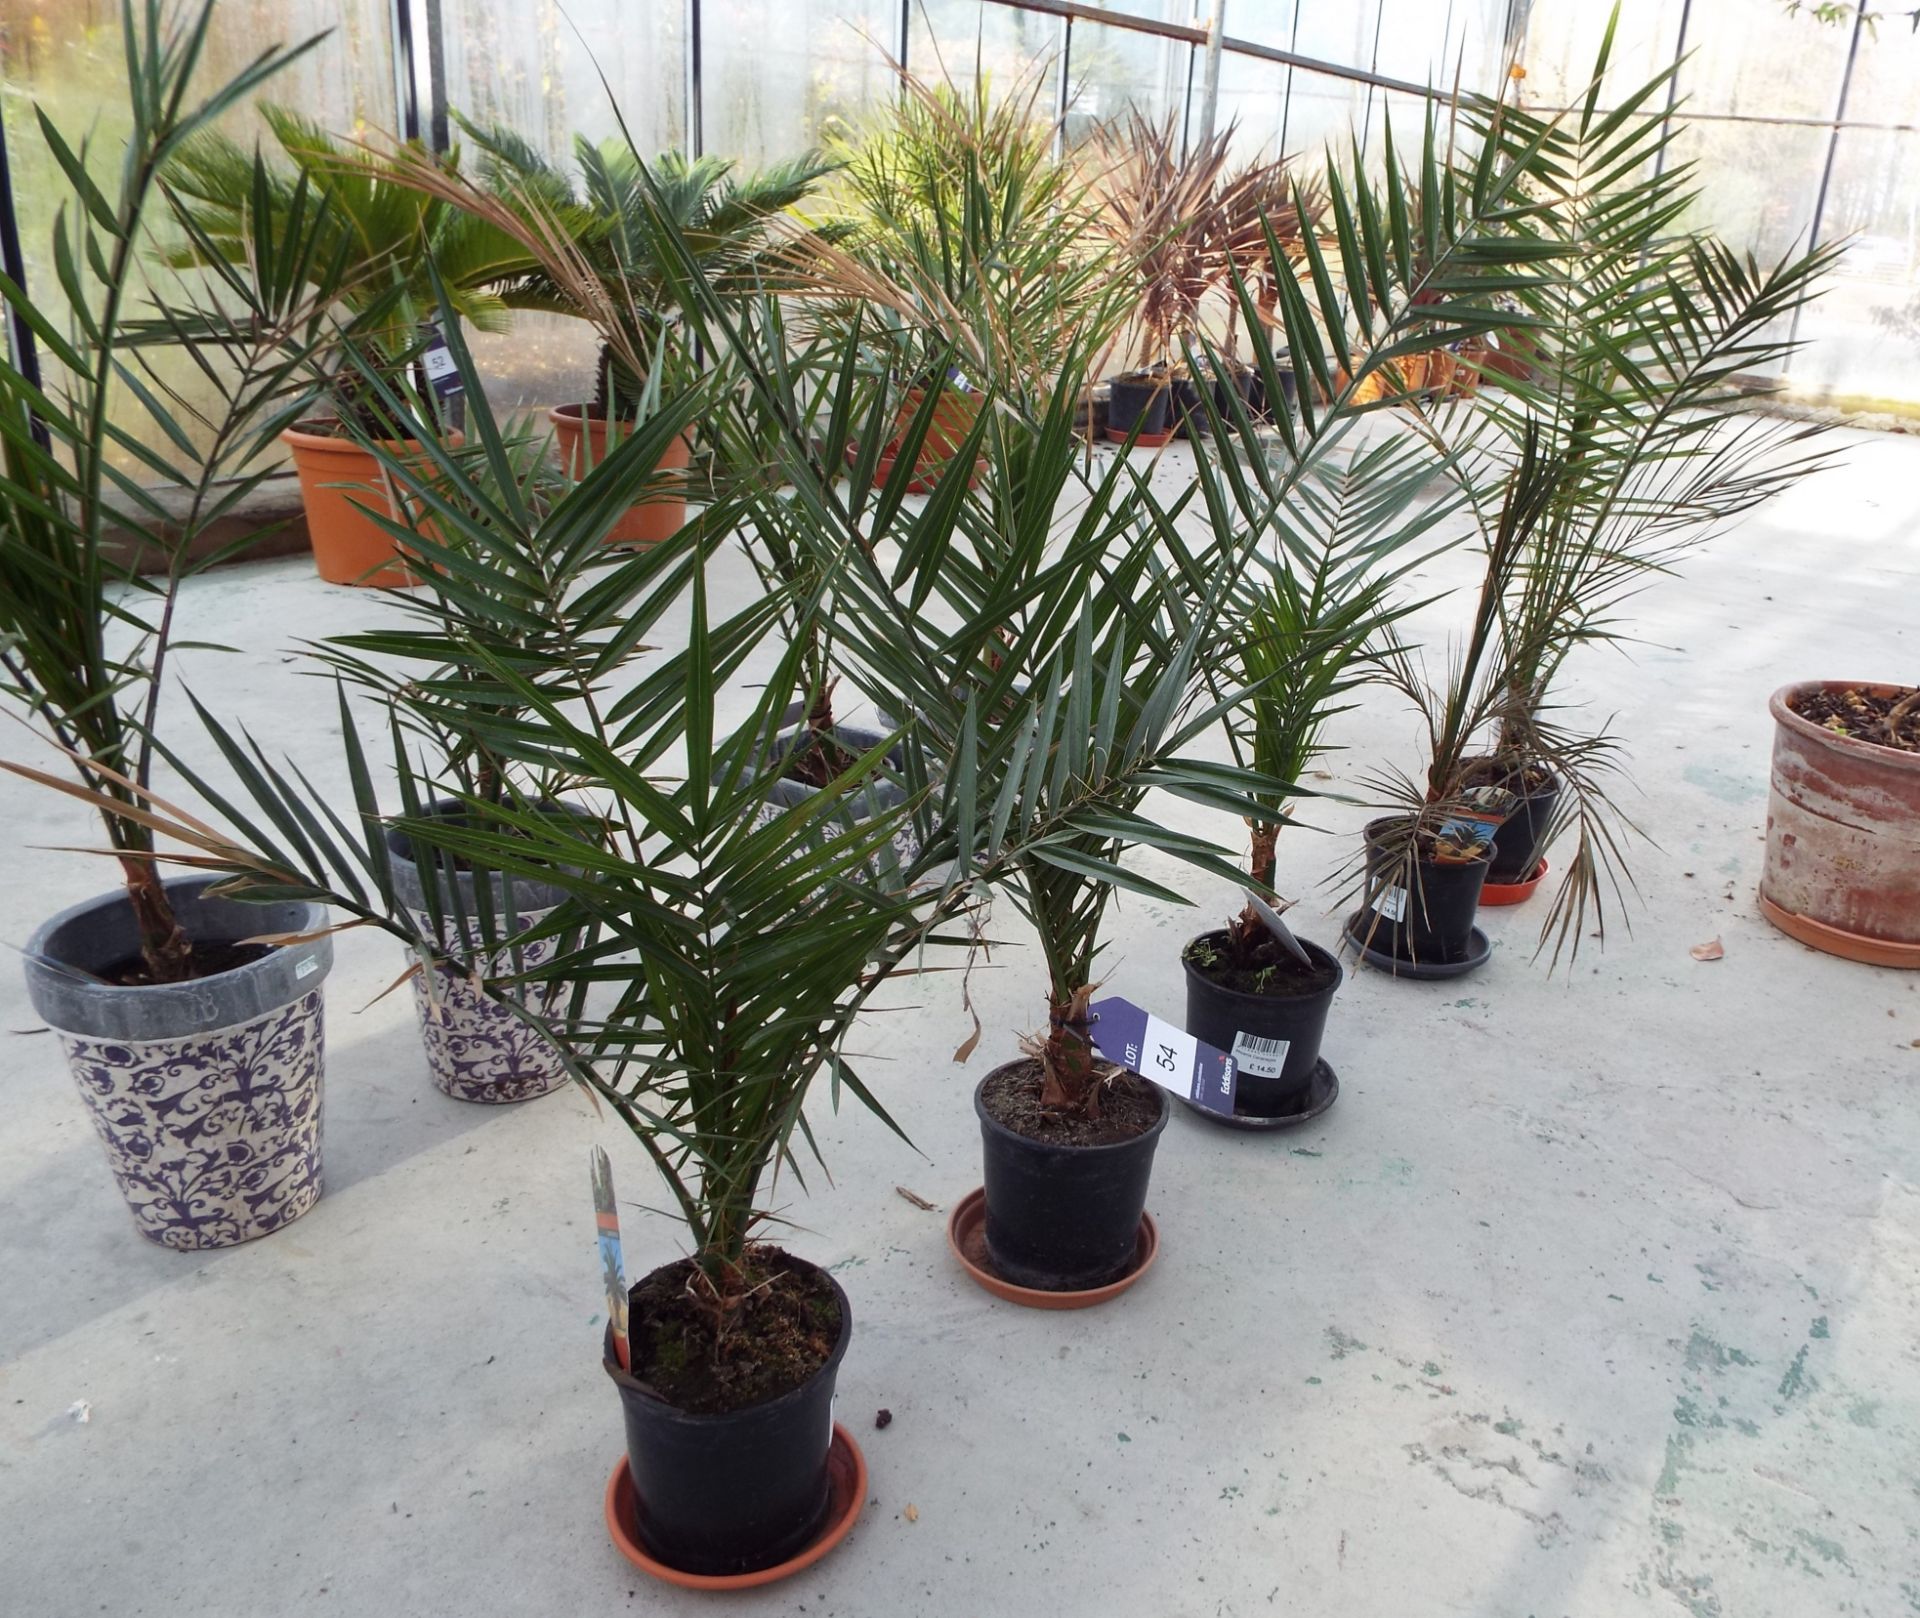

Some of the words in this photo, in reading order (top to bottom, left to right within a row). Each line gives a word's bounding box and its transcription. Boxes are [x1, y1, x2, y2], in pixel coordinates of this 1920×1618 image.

[1125, 1043, 1138, 1067] LOT:
[1156, 1044, 1178, 1072] 54
[1221, 1057, 1233, 1095] Eddisons
